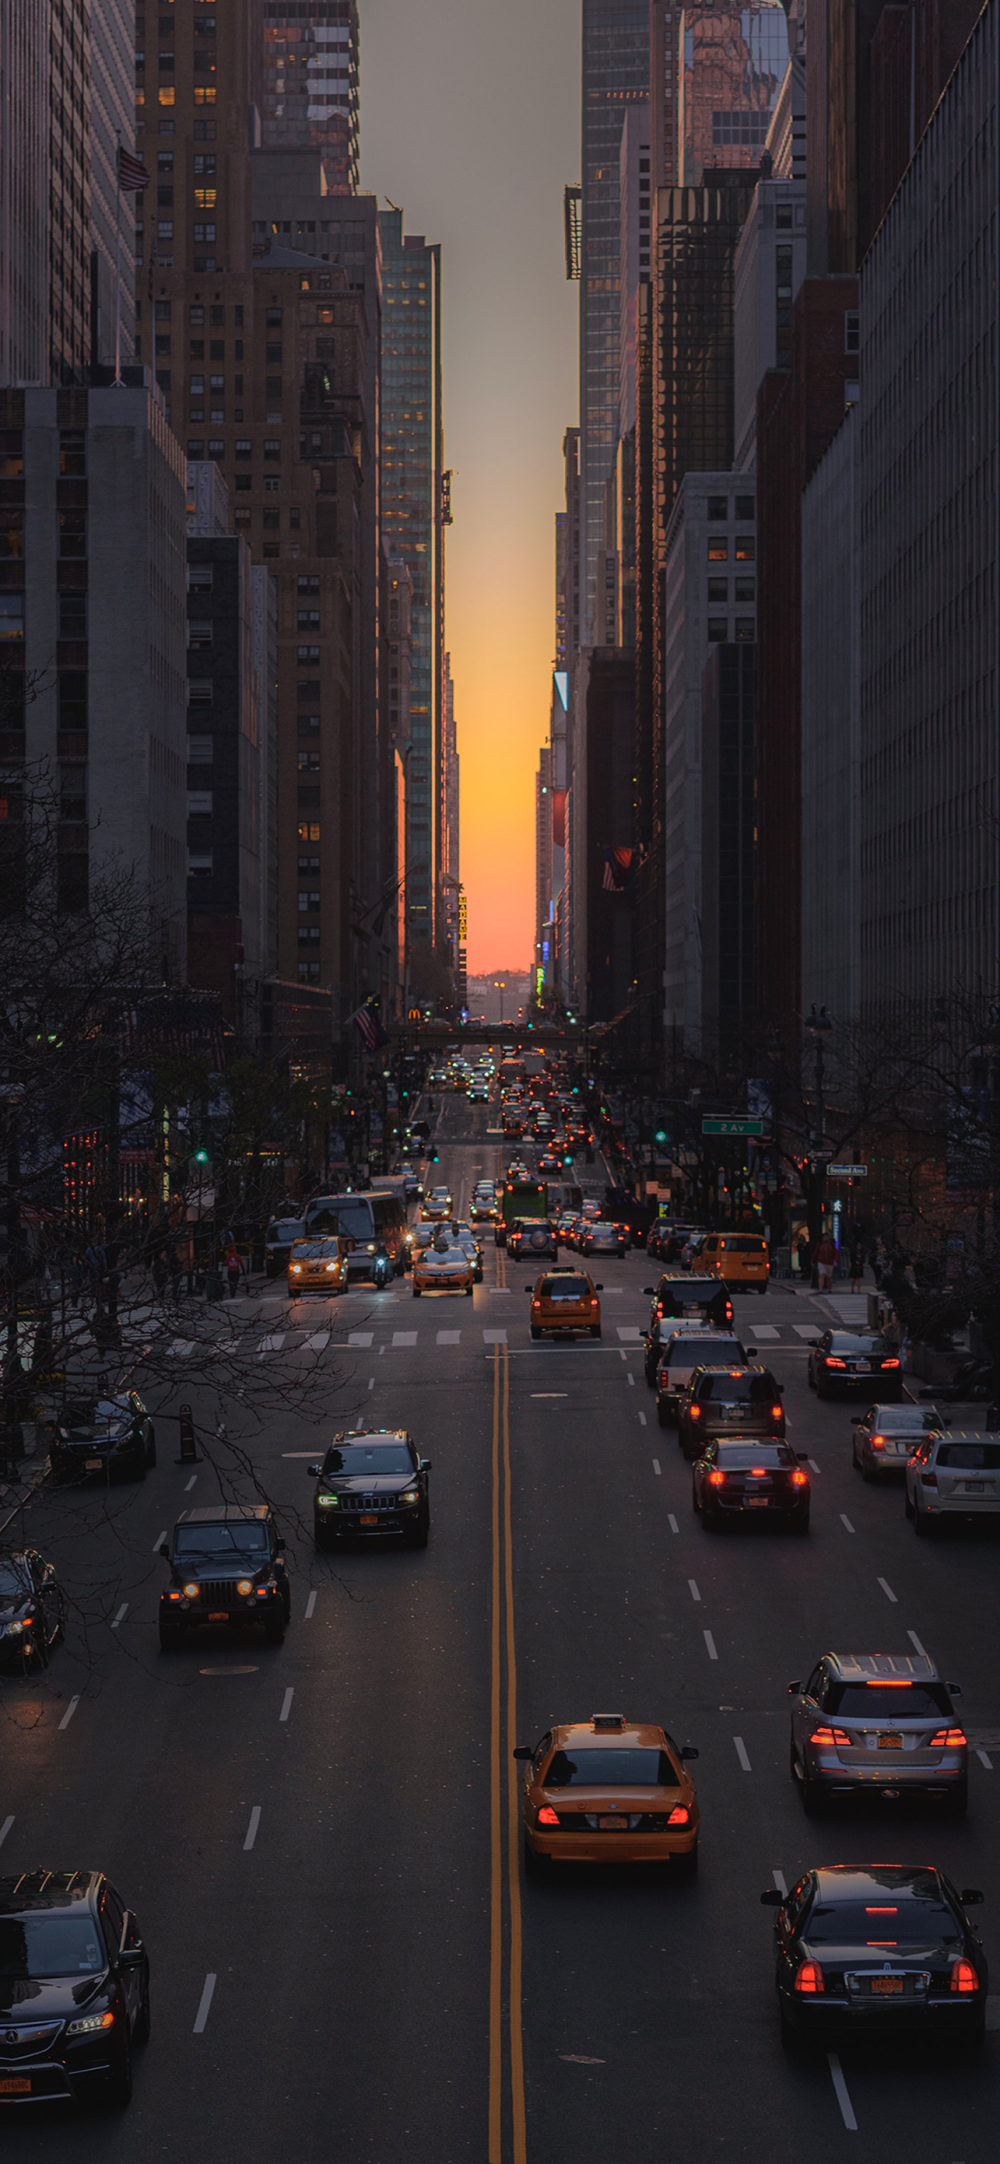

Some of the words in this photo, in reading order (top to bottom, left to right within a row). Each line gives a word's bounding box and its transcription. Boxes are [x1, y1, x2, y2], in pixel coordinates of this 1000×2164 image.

[459, 896, 467, 940] MADAME
[720, 1123, 727, 1131] 2
[730, 1124, 744, 1132] Av
